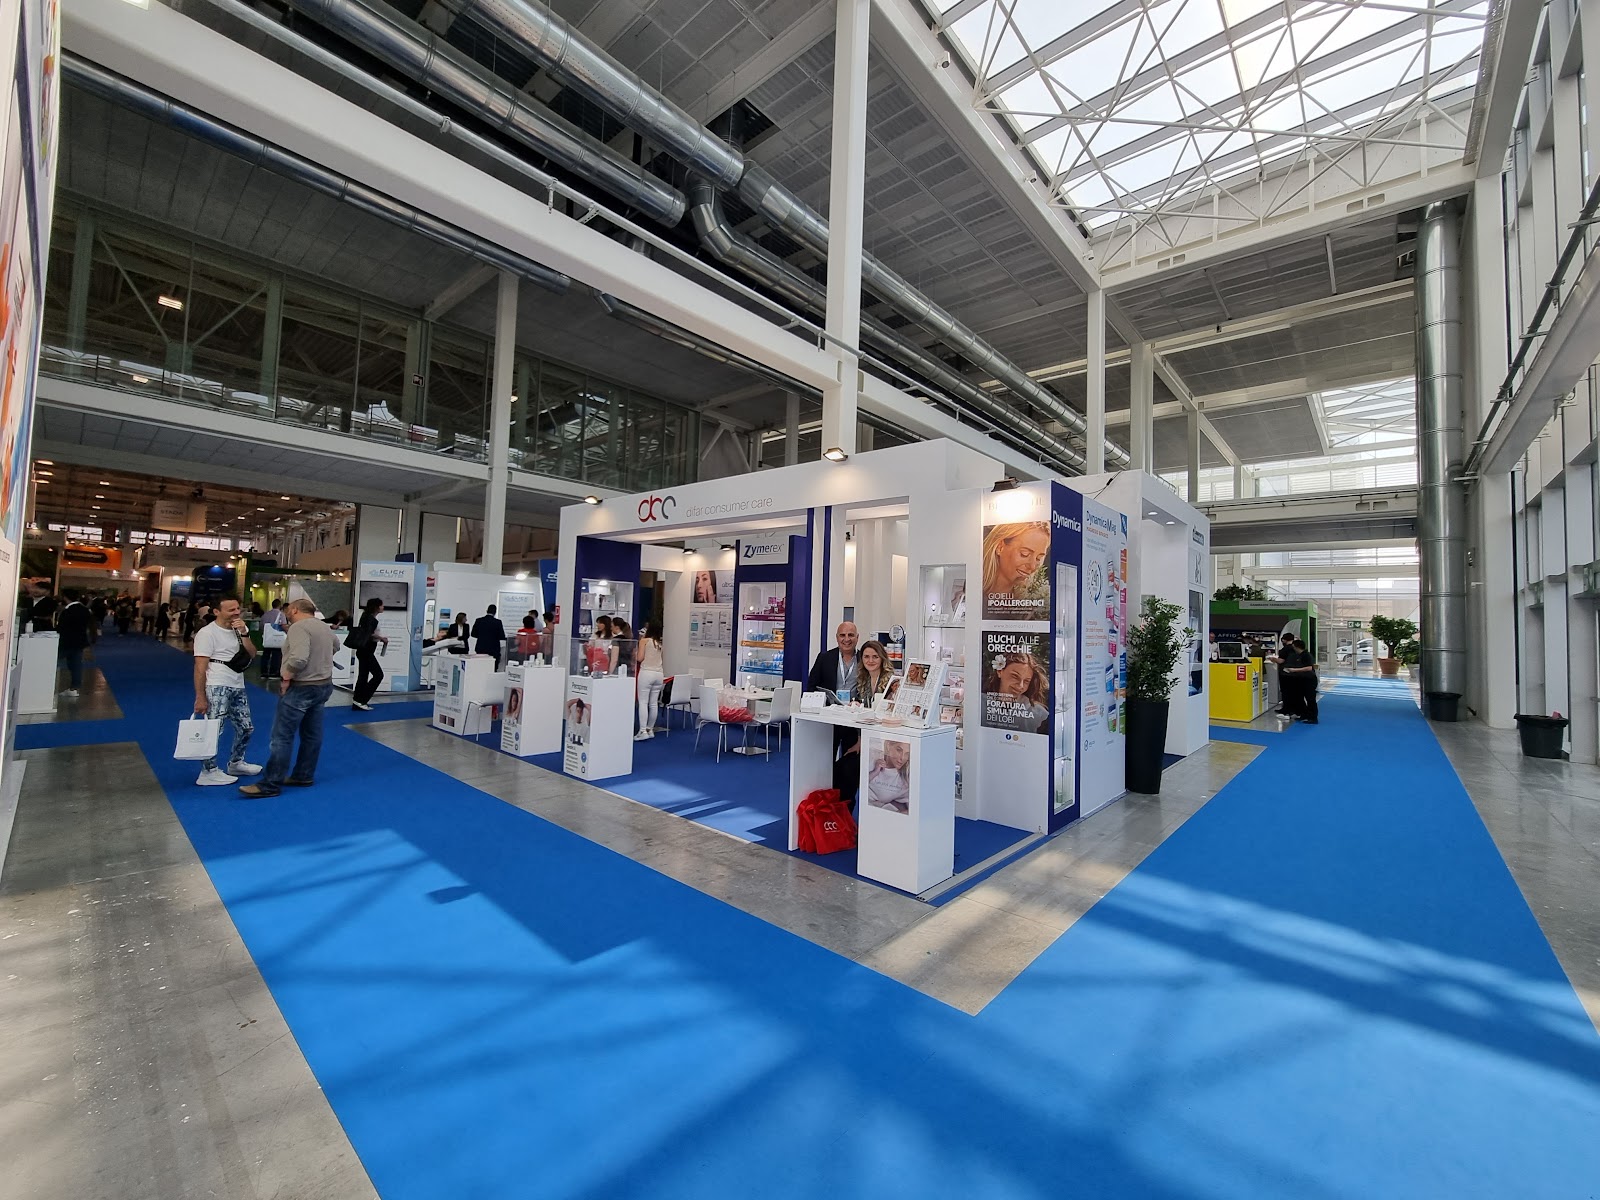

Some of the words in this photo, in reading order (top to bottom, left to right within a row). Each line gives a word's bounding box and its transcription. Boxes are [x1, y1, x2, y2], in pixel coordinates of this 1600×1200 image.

[686, 504, 704, 518] difar
[704, 500, 749, 516] consumer
[751, 497, 773, 509] care
[1052, 510, 1081, 533] Dynamica
[743, 543, 783, 558] Zymerex
[988, 592, 1014, 600] GIOIELLI
[987, 599, 1044, 607] IPOALLERGENICI
[987, 634, 1015, 644] BUCHI
[1018, 635, 1040, 645] ALLE
[987, 644, 1032, 654] ORECCHIE
[1238, 666, 1245, 674] E
[986, 699, 1026, 710] FORATURA
[986, 707, 1035, 719] SIMULTANEA
[986, 714, 997, 722] DEI
[998, 715, 1015, 724] LOBI
